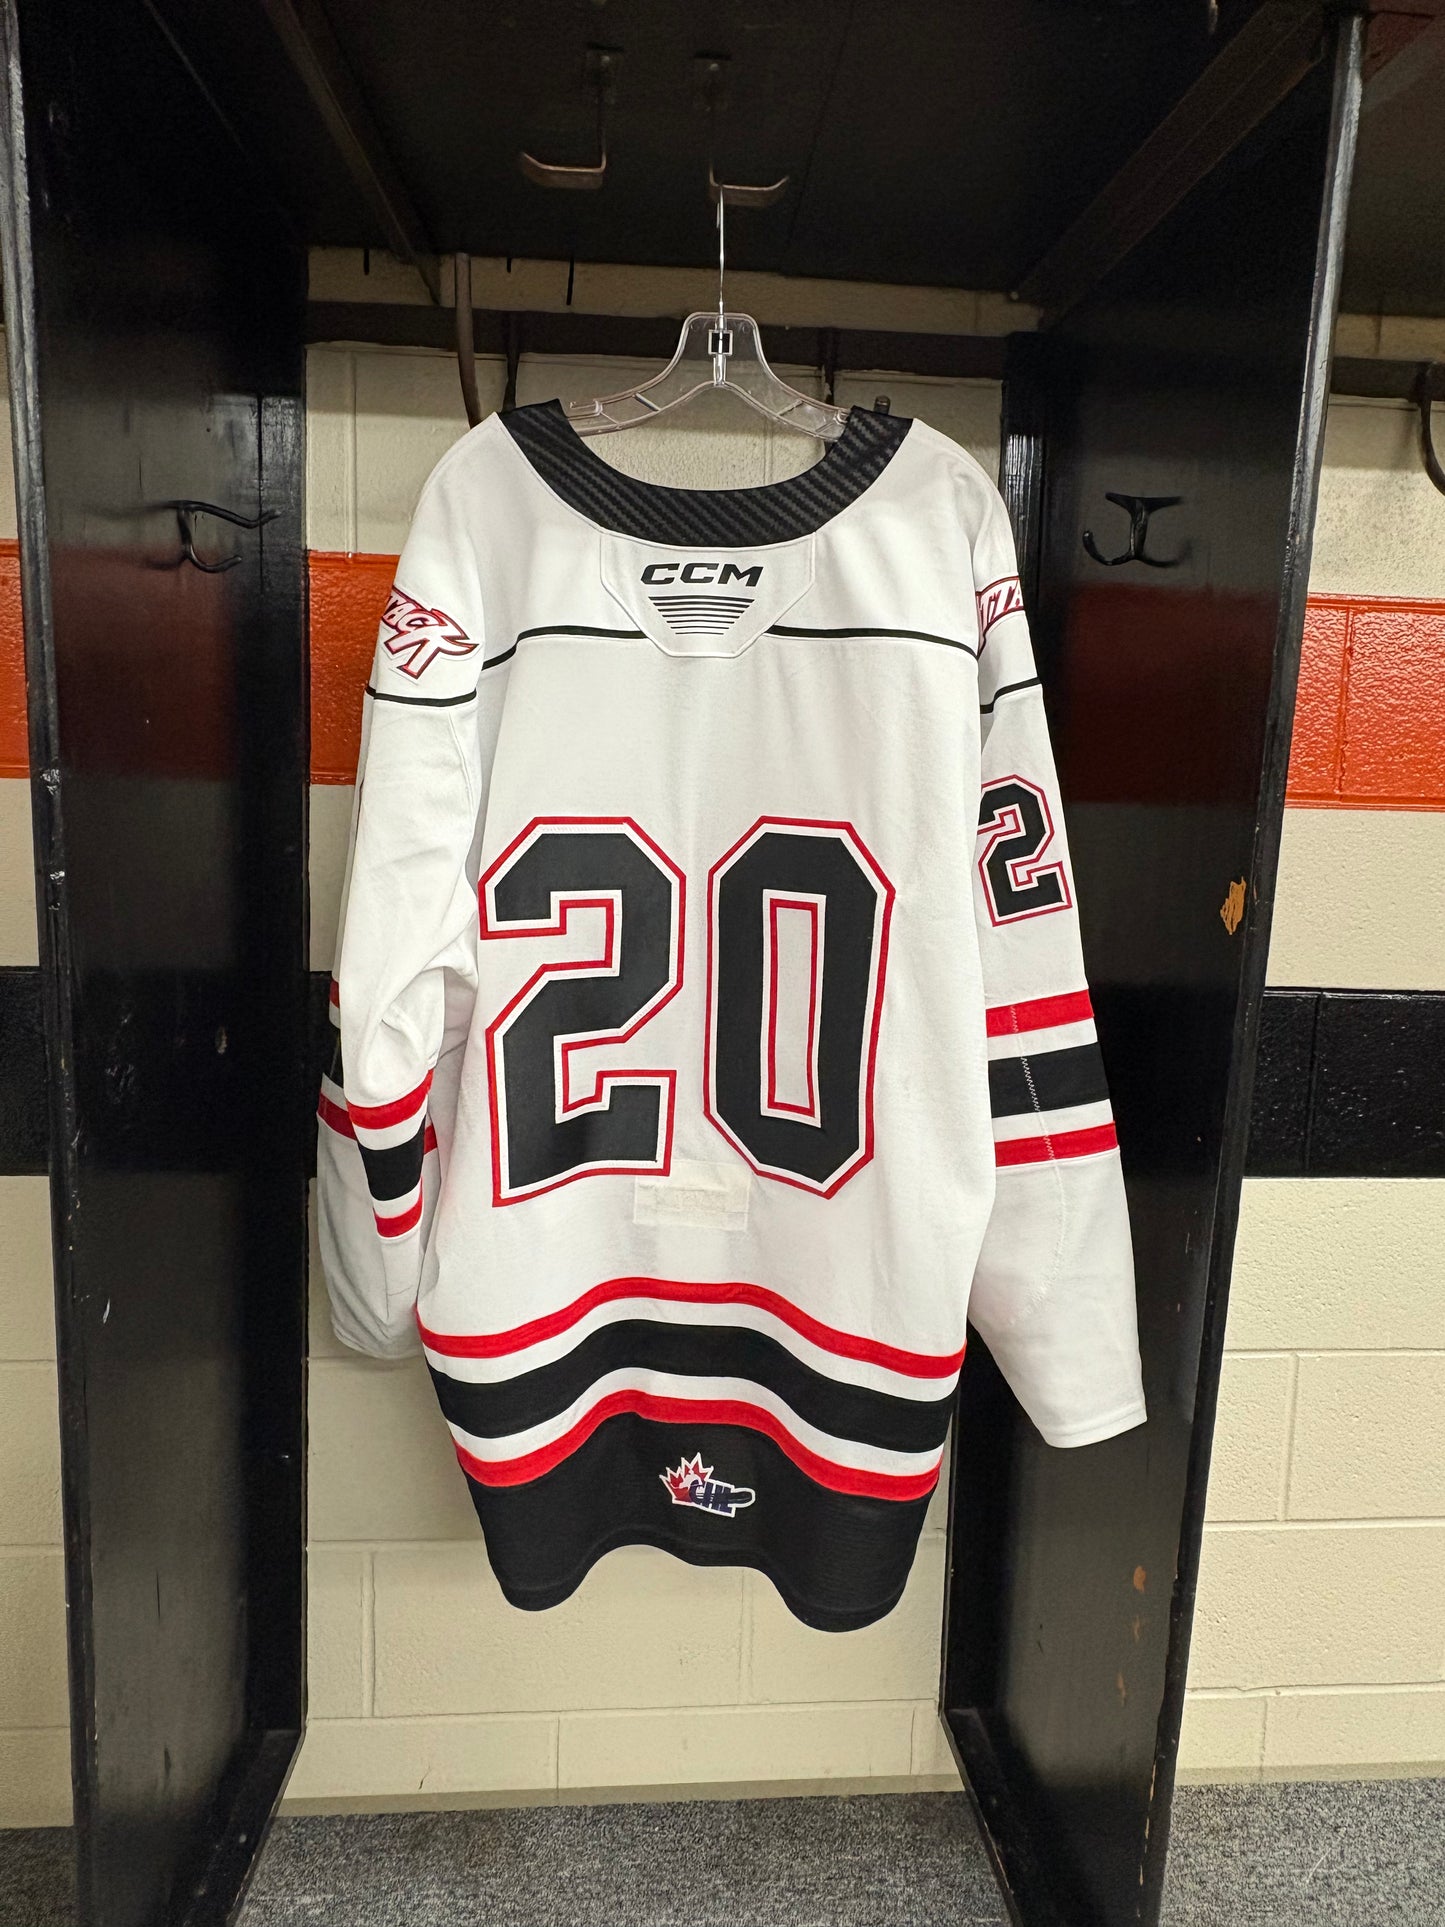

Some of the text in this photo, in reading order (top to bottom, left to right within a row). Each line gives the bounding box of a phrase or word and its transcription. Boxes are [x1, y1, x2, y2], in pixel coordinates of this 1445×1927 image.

[640, 562, 764, 587] CCM
[977, 774, 1072, 927] 2
[477, 815, 896, 1208] 20
